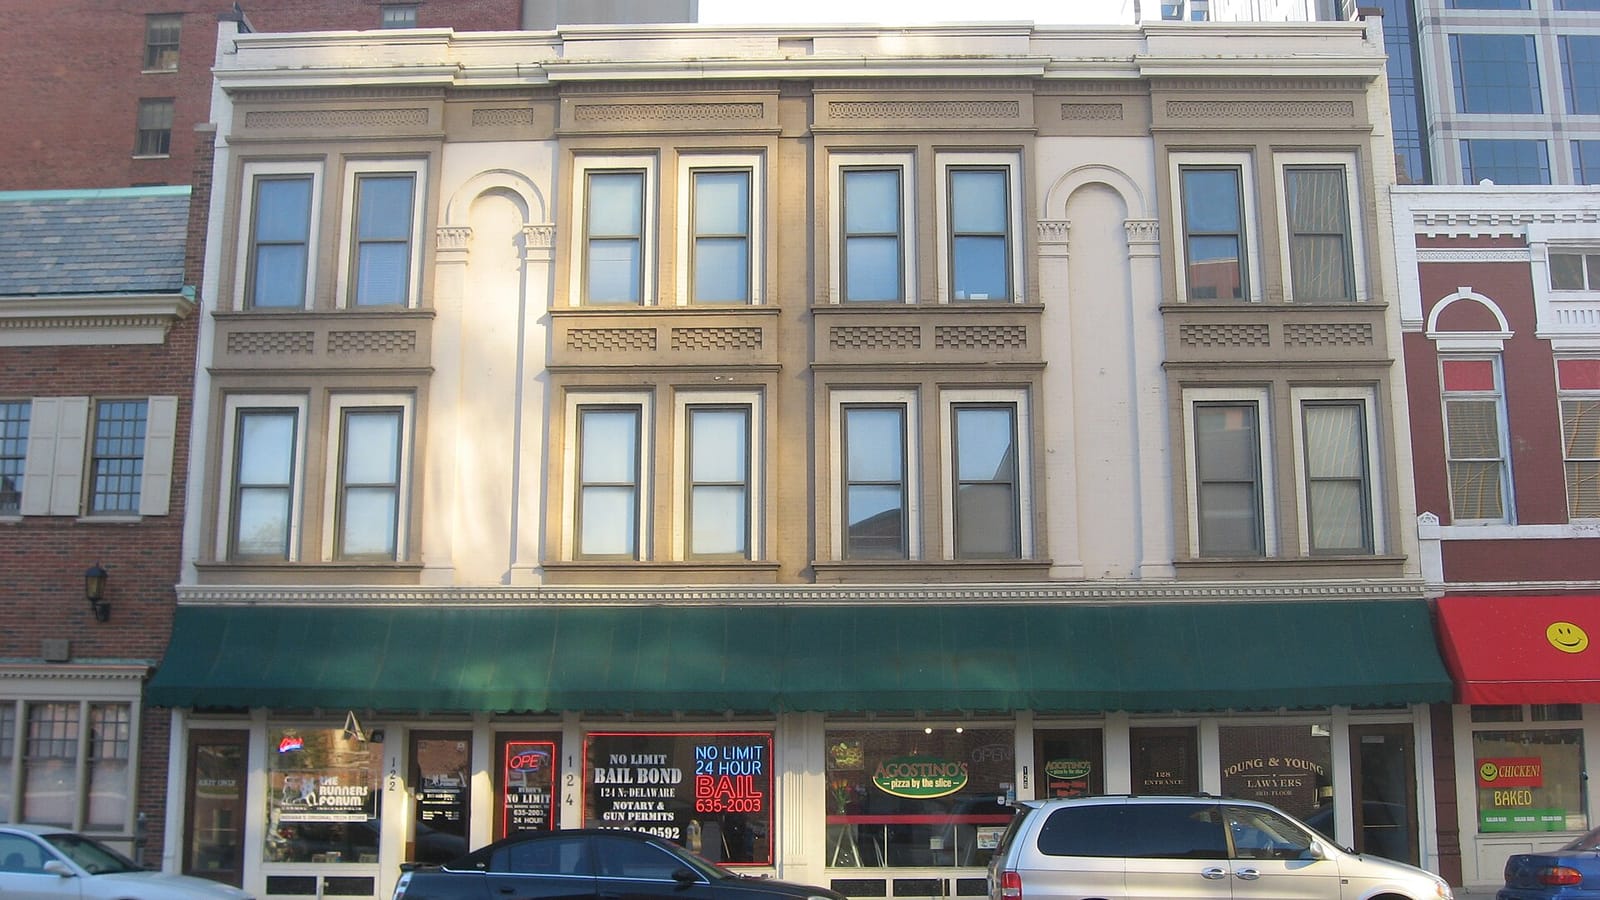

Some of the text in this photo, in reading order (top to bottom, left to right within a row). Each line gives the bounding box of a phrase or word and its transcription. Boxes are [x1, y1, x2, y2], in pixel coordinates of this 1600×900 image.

[610, 754, 667, 764] NO LIMIT
[696, 746, 764, 760] NO LIMIT
[972, 750, 1011, 763] OPEN
[510, 754, 549, 769] OPEN
[696, 760, 762, 775] 24 HOUR
[1224, 757, 1325, 778] YOUNG & YOUNG
[874, 760, 968, 778] AGOSTINO'S
[1499, 764, 1541, 778] CHICKEN!
[594, 768, 682, 784] BAIL BOND
[696, 774, 763, 798] BAIL
[890, 778, 952, 790] pizza by the slice
[1247, 778, 1302, 788] LAWYERS
[320, 786, 368, 796] RUNNERS
[600, 788, 615, 798] 124
[629, 788, 676, 798] DELAWARE
[320, 796, 362, 806] FORUM
[506, 794, 551, 804] NO LIMIT
[1494, 790, 1532, 806] BAKED
[613, 801, 664, 810] NOTARY &
[696, 798, 761, 812] 635-2003
[603, 812, 674, 821] GUN PERMITS
